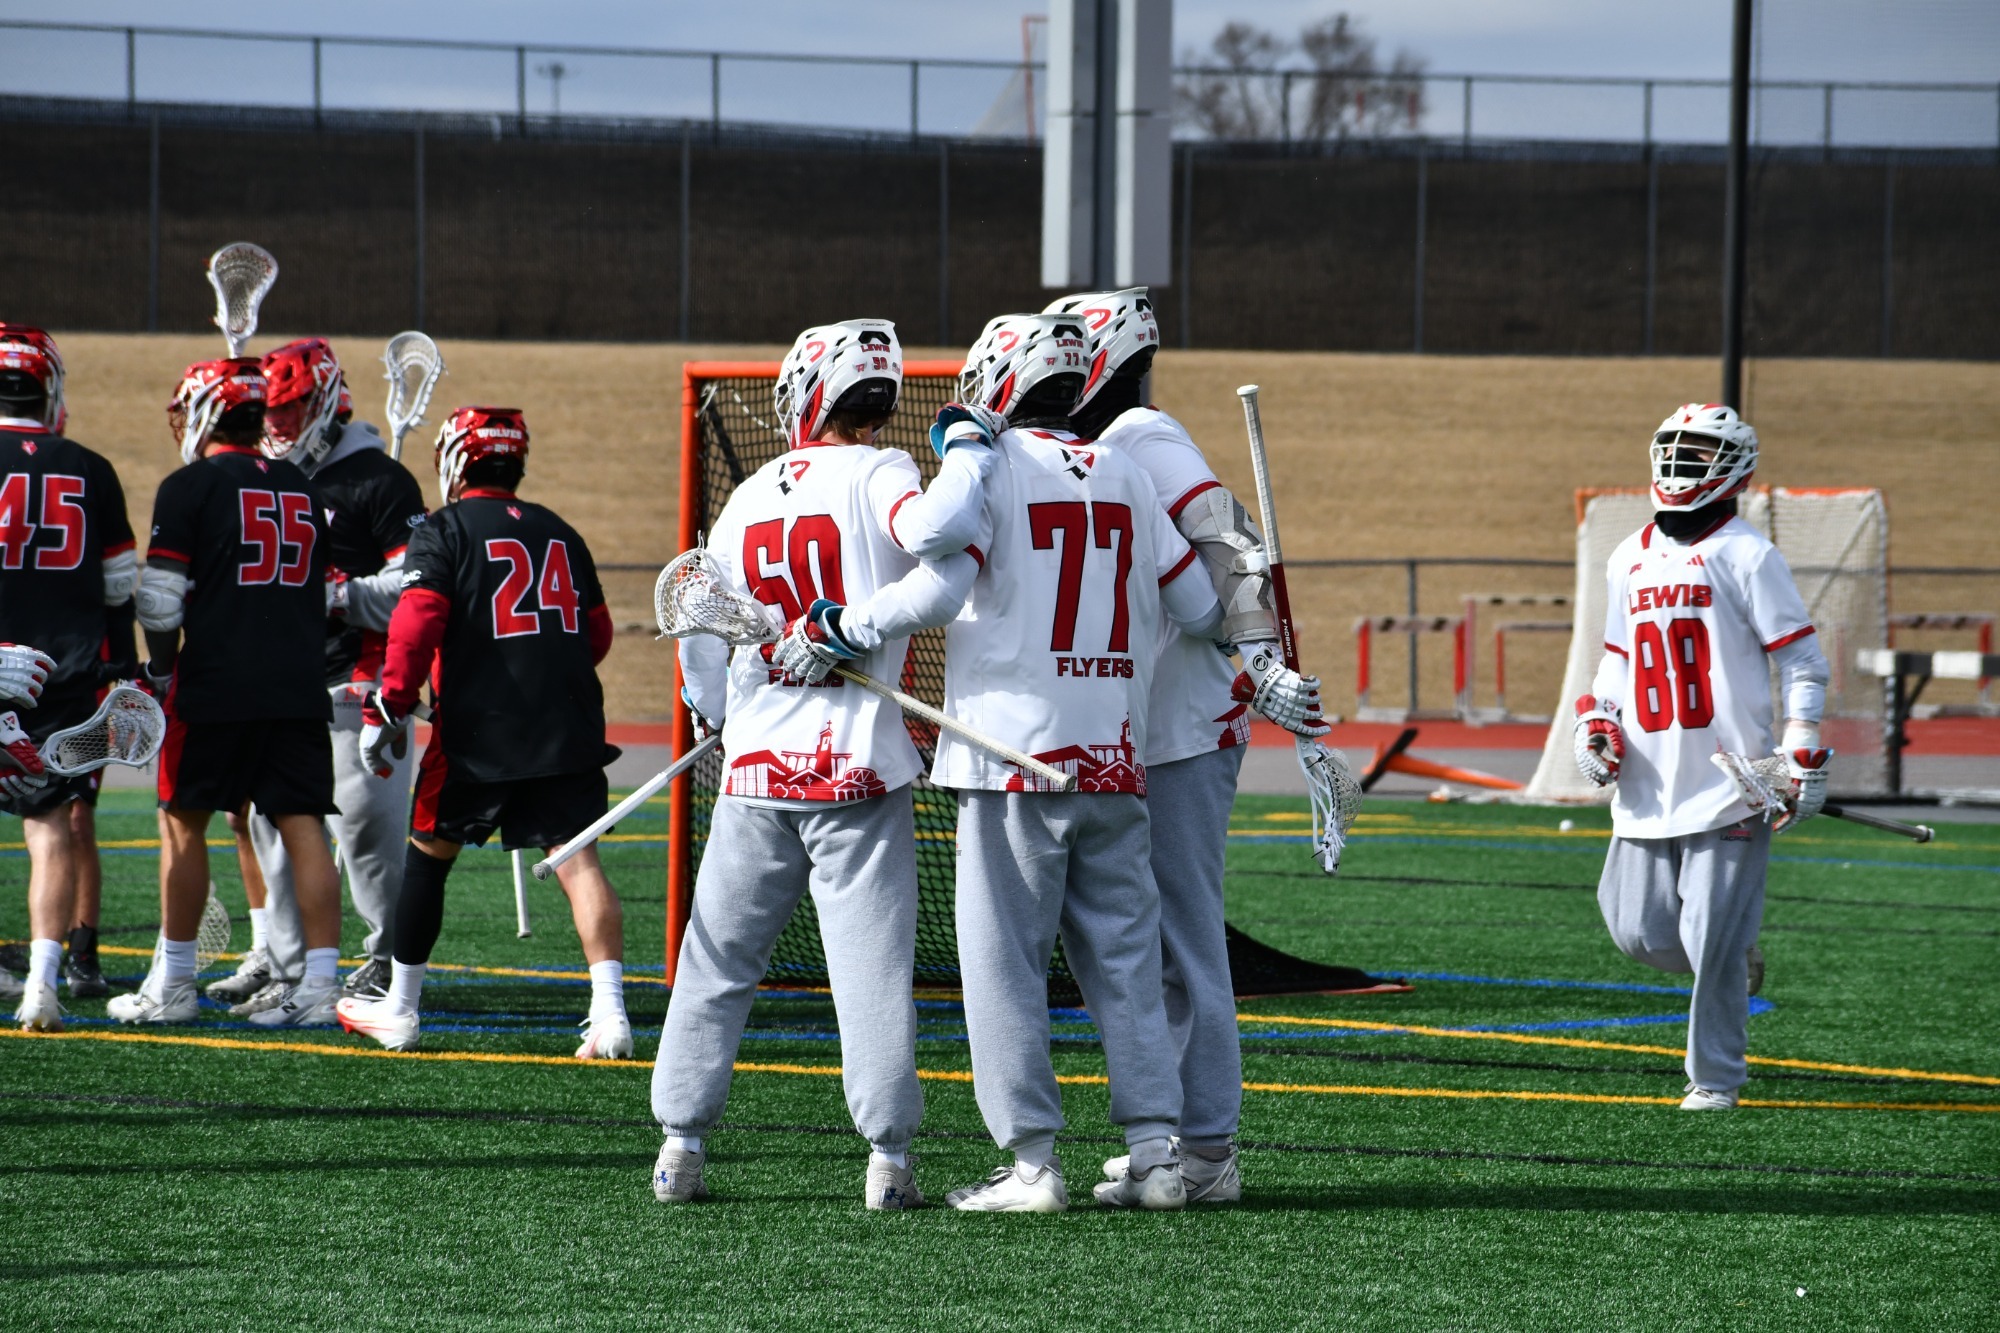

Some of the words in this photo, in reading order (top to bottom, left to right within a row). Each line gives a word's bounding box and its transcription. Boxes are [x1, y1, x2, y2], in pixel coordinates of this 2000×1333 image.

[1064, 352, 1080, 366] 77
[476, 428, 522, 440] WOLVES
[0, 473, 85, 569] 45
[238, 488, 317, 585] 55
[485, 538, 580, 639] 24
[1027, 501, 1134, 653] 77
[1629, 584, 1712, 616] LEWIS
[1283, 625, 1293, 658] CARBON
[1056, 657, 1134, 679] FLYERS
[1253, 667, 1280, 710] AVERIK
[1635, 618, 1714, 733] 88
